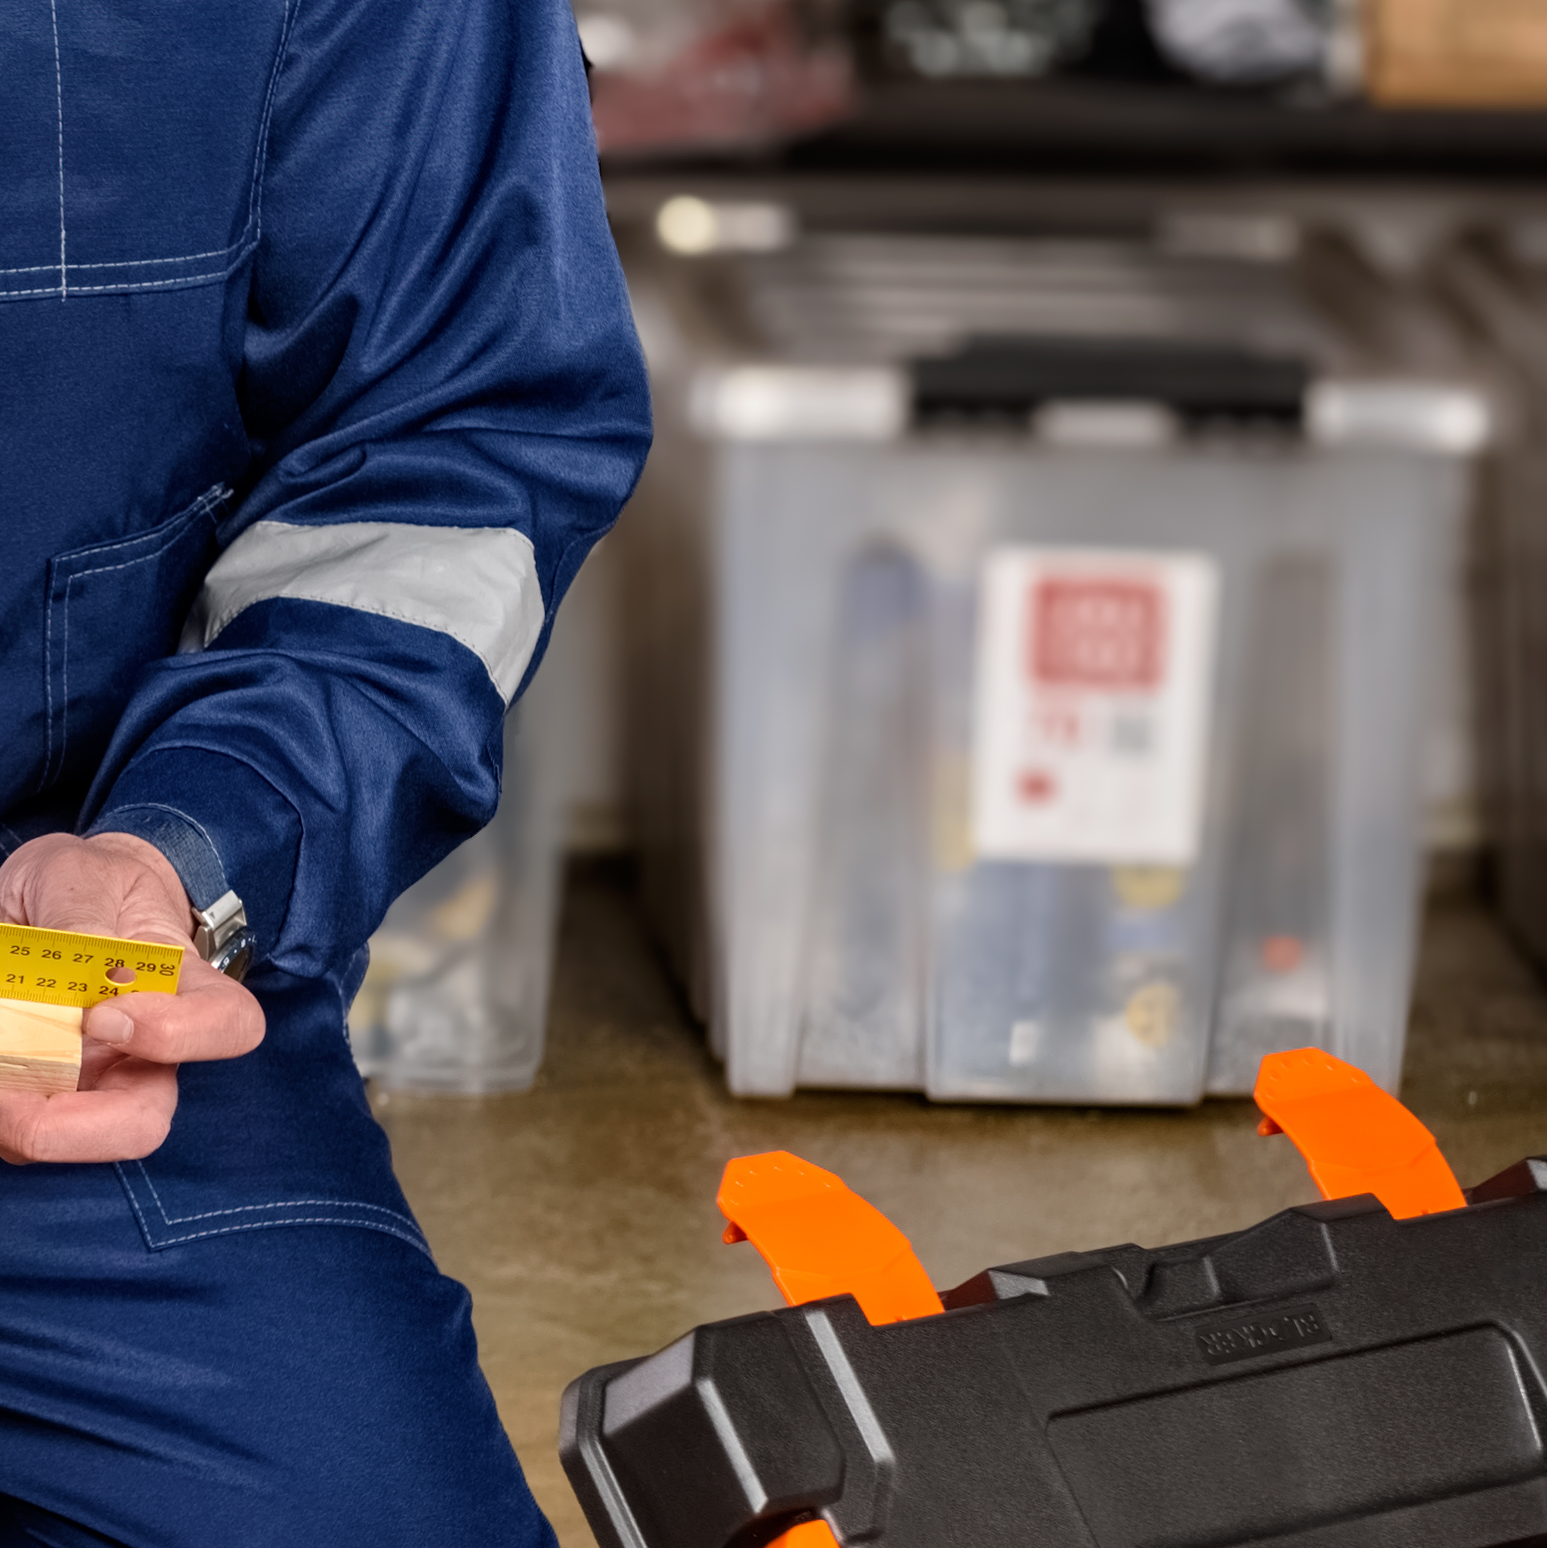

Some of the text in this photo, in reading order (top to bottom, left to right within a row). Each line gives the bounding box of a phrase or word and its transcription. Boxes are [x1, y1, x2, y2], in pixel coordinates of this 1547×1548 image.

[9, 945, 31, 956] 25
[41, 949, 62, 960] 26
[72, 953, 94, 964] 27
[104, 957, 125, 969] 28
[135, 961, 157, 973] 29
[158, 963, 176, 977] 30
[6, 973, 25, 984] 21
[35, 977, 57, 989] 22
[67, 981, 88, 993] 23
[98, 985, 119, 997] 24
[1198, 1314, 1320, 1355] BLOCKER
